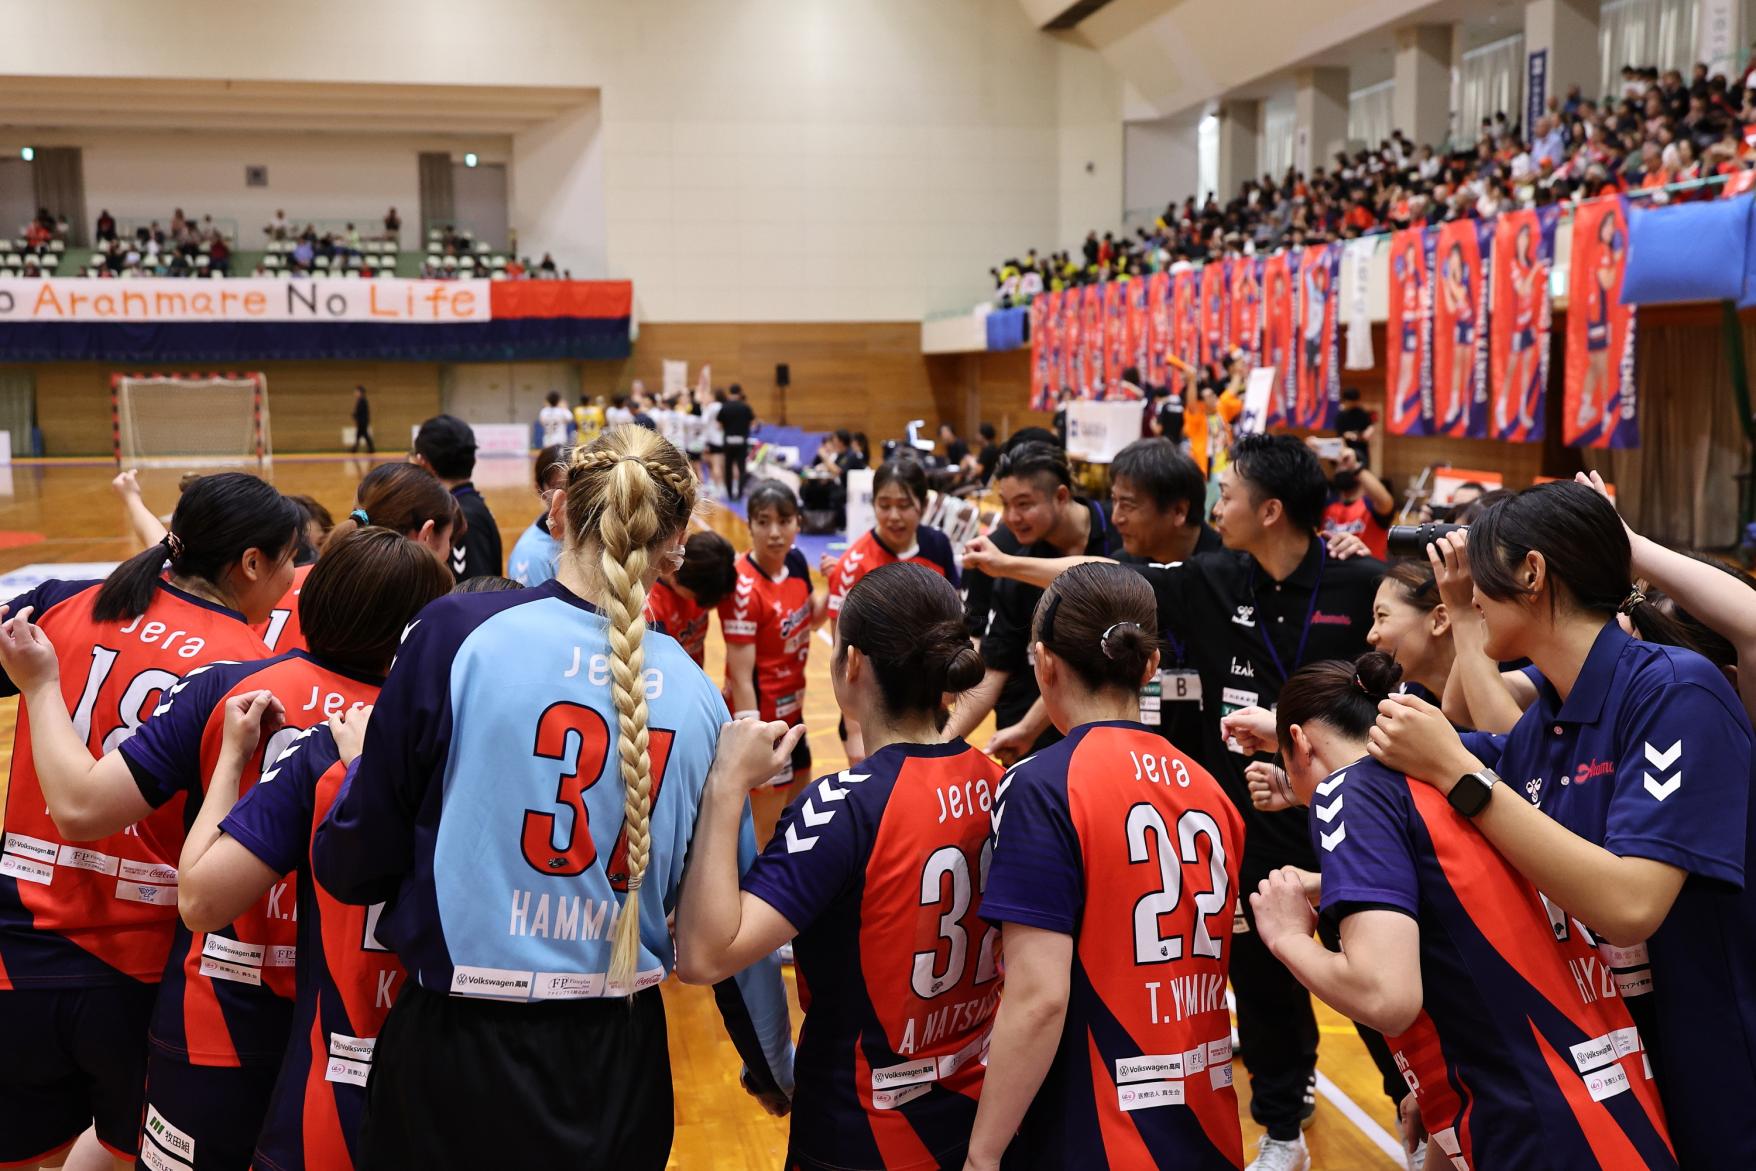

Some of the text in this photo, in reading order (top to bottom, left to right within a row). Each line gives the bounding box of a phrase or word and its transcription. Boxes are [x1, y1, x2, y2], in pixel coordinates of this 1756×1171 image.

[32, 283, 268, 317] Aranmare
[287, 283, 347, 316] No
[369, 283, 477, 317] Life
[120, 613, 206, 659] Jera
[563, 645, 664, 701] Jea
[1176, 677, 1188, 697] B
[71, 643, 182, 759] 18
[1129, 751, 1191, 789] Jera
[936, 778, 992, 825] Jera
[1124, 800, 1230, 967] 22
[468, 975, 514, 989] Volkswagen
[884, 1069, 922, 1080] Volkswagen
[1129, 1064, 1169, 1073] Volkswagen
[165, 1130, 191, 1154] 牧田組
